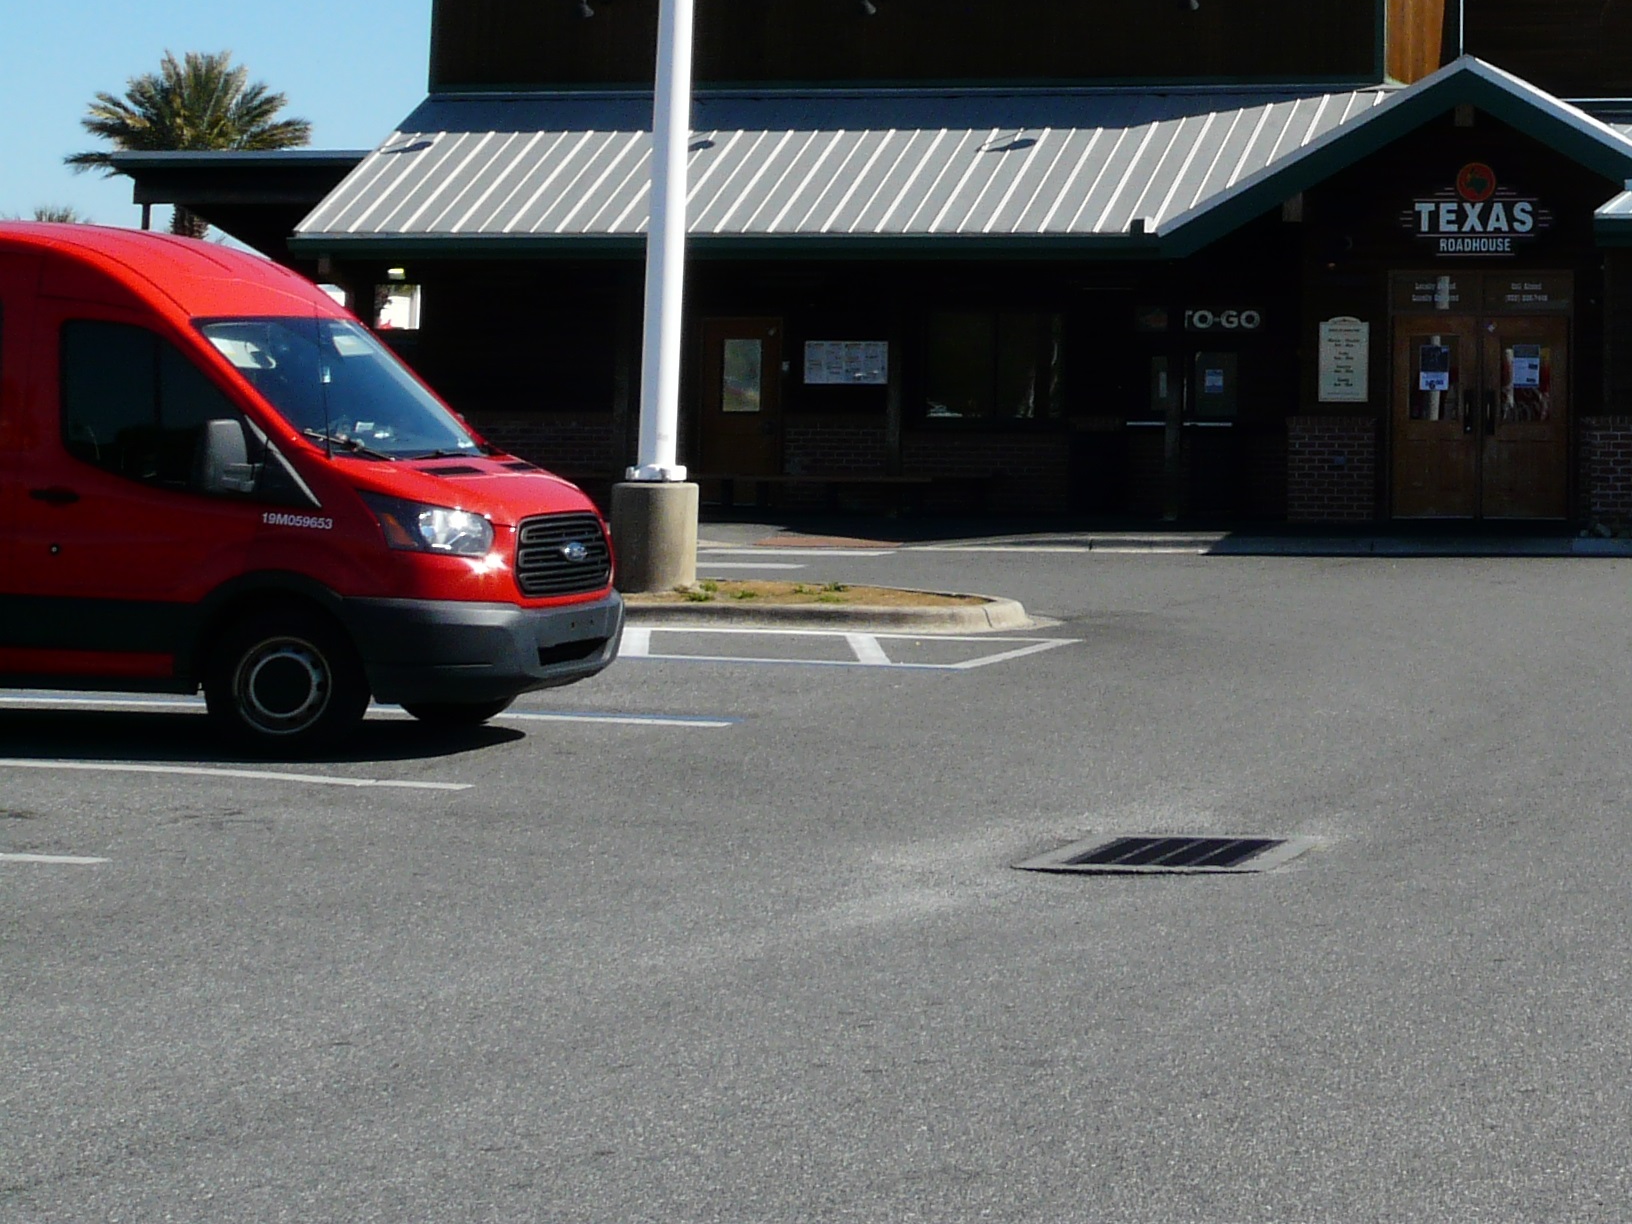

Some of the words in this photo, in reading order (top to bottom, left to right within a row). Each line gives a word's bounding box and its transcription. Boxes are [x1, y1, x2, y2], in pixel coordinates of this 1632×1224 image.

[1414, 201, 1534, 233] TEXAS
[1439, 238, 1511, 252] ROADHOUSE
[262, 512, 333, 530] 19M059653
